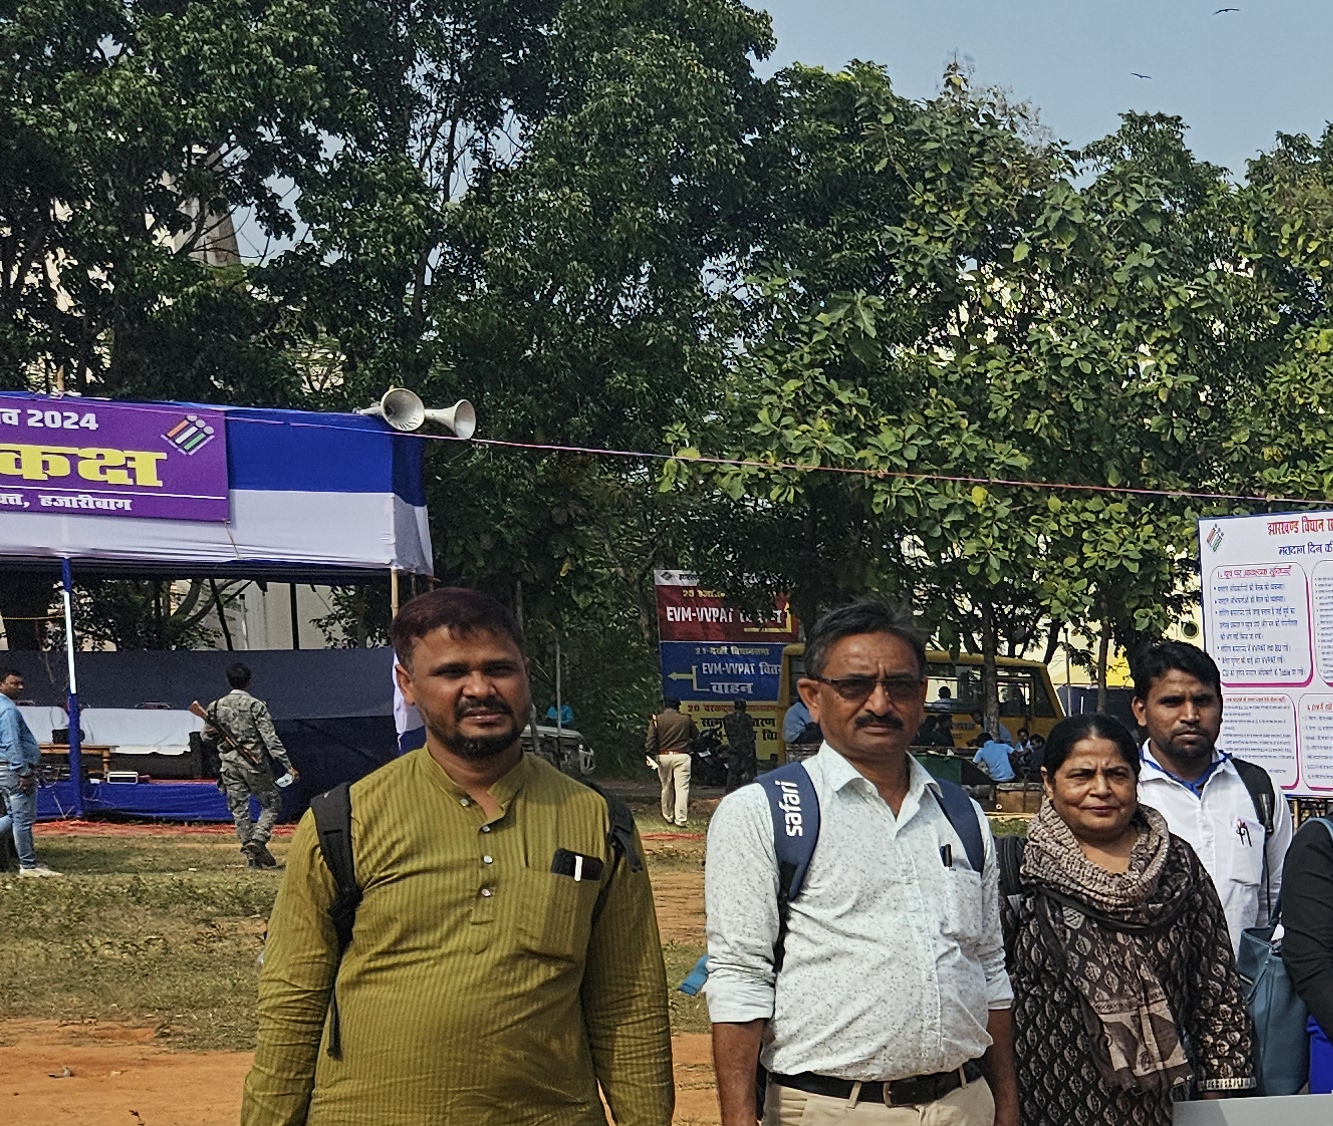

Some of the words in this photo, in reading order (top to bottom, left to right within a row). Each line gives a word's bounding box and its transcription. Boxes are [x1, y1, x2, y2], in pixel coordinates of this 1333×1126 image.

[27, 410, 99, 430] 2024
[39, 494, 133, 511] हजारीबाग
[702, 662, 756, 675] EVM-VVPAT
[774, 780, 803, 837] safari
